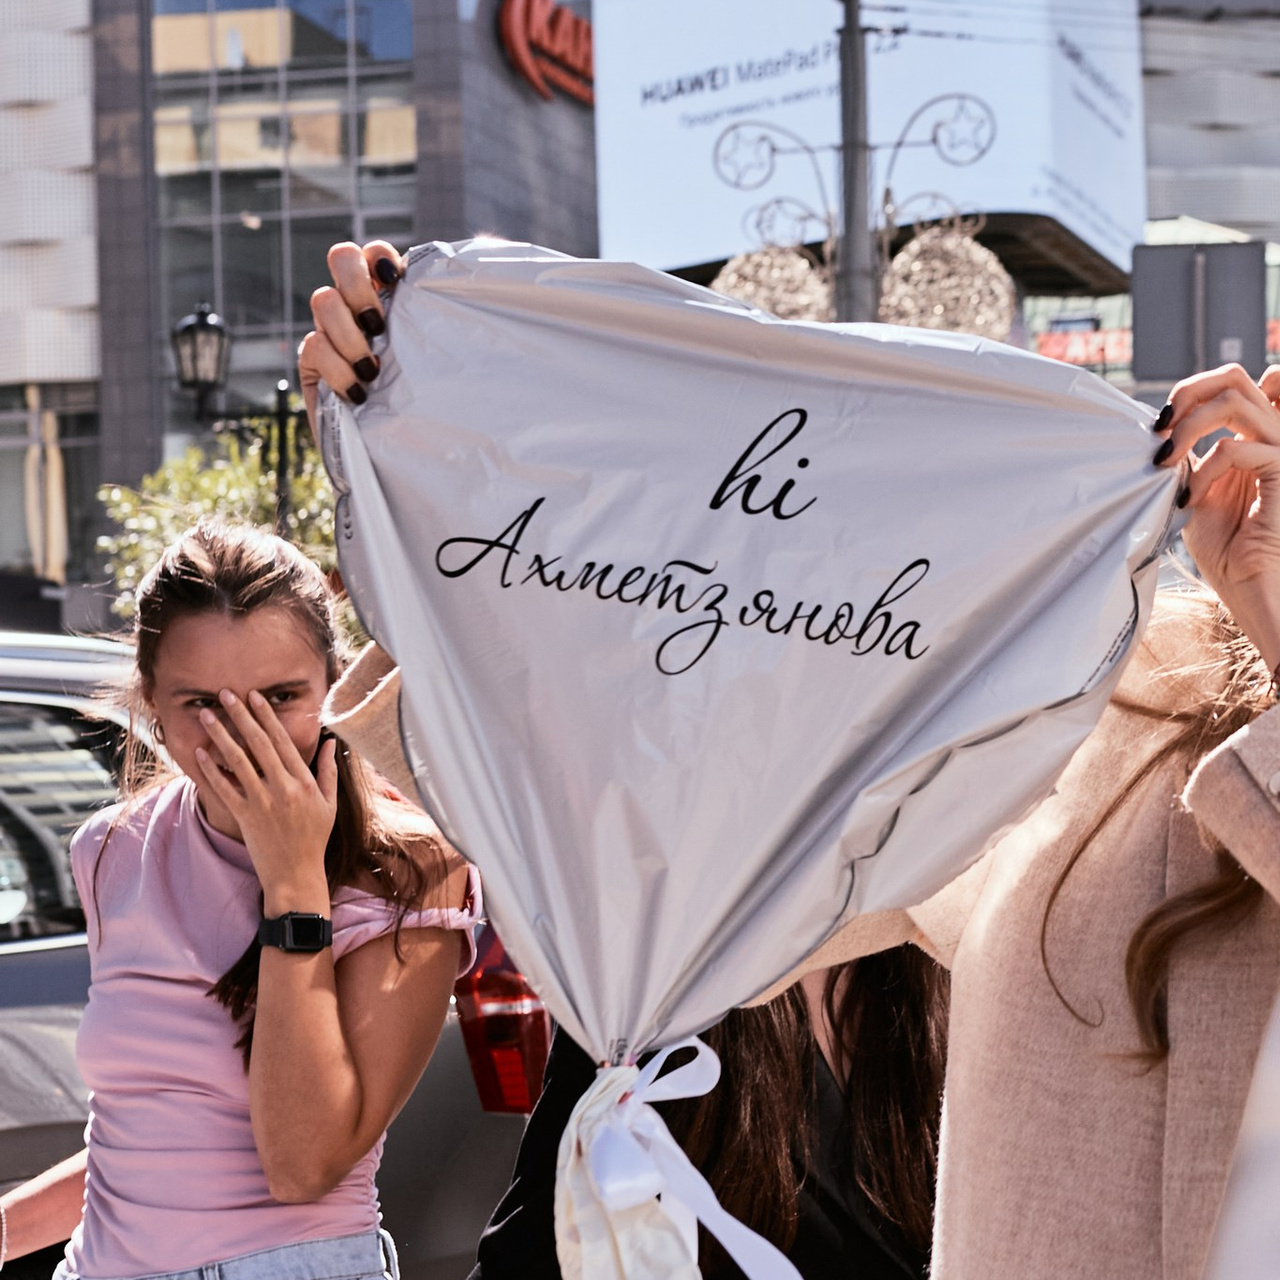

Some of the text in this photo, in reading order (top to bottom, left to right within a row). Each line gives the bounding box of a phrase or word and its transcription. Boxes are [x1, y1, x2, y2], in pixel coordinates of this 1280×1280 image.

[640, 66, 729, 107] HUAWEI
[709, 407, 818, 520] hi
[435, 497, 932, 676] Ахметзянова
